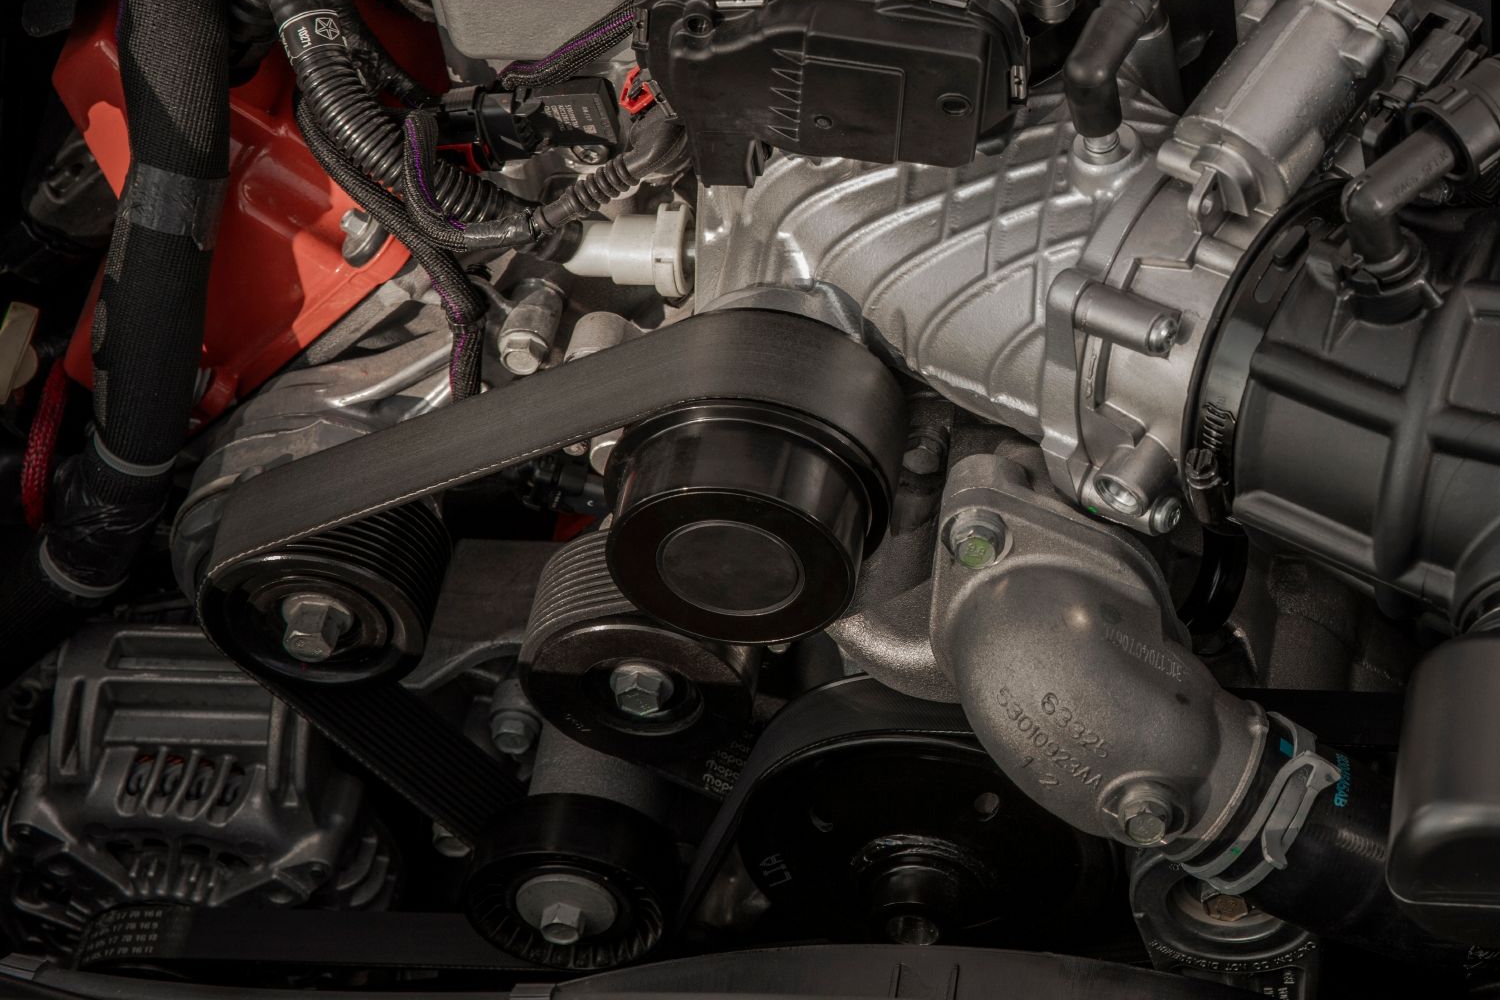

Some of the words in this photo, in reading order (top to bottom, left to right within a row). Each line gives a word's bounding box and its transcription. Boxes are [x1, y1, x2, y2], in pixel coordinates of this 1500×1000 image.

[297, 26, 312, 48] 10271
[996, 686, 1105, 791] 53010923AA
[1041, 691, 1114, 759] 63325
